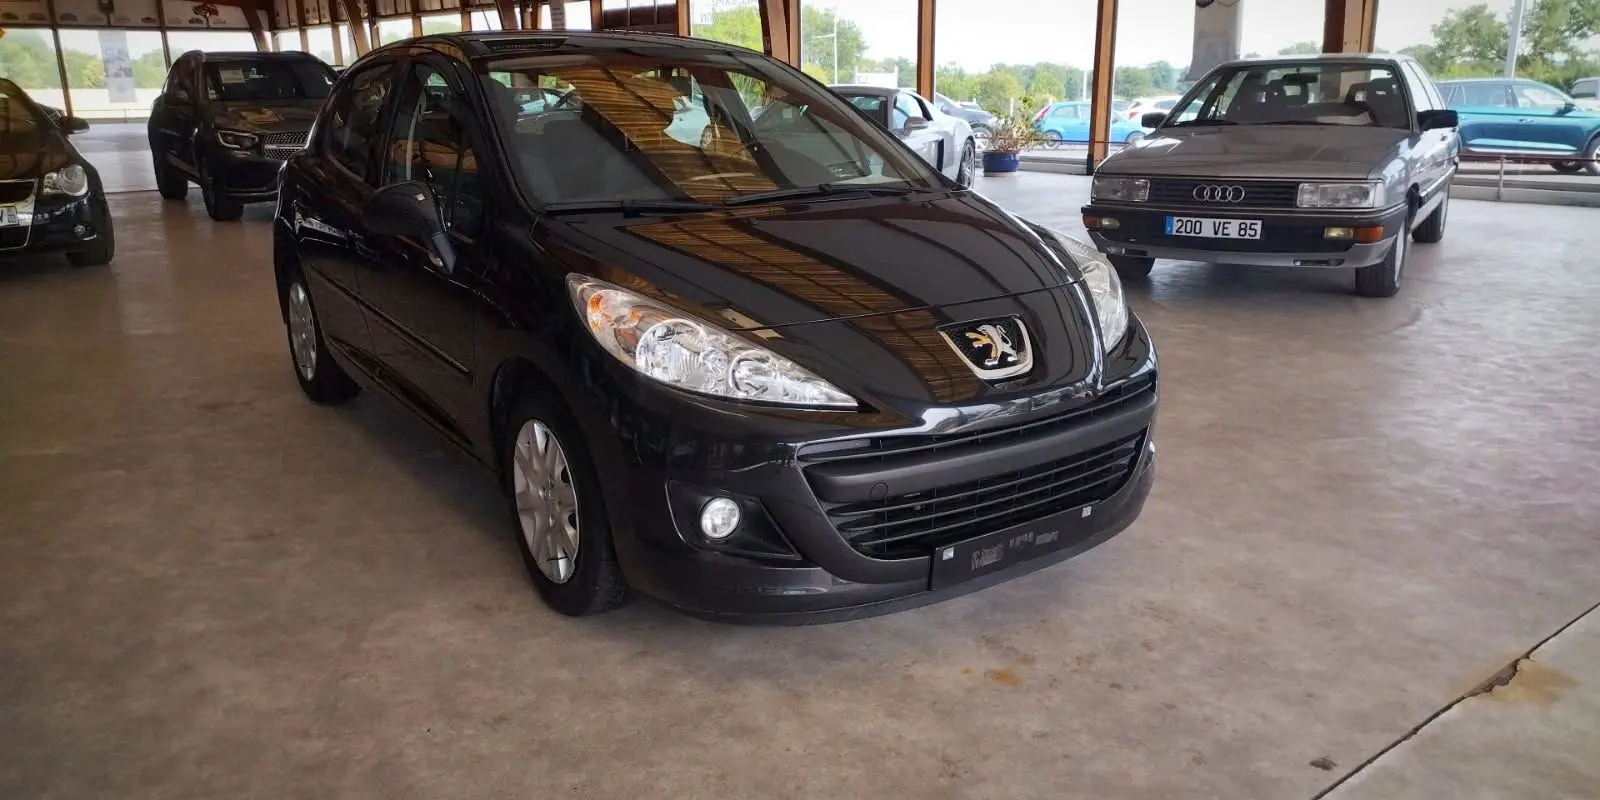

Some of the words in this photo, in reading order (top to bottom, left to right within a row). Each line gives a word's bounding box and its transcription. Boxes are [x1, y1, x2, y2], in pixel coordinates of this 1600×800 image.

[1175, 219, 1202, 235] 200
[1213, 220, 1232, 236] VE
[1238, 222, 1258, 237] 85
